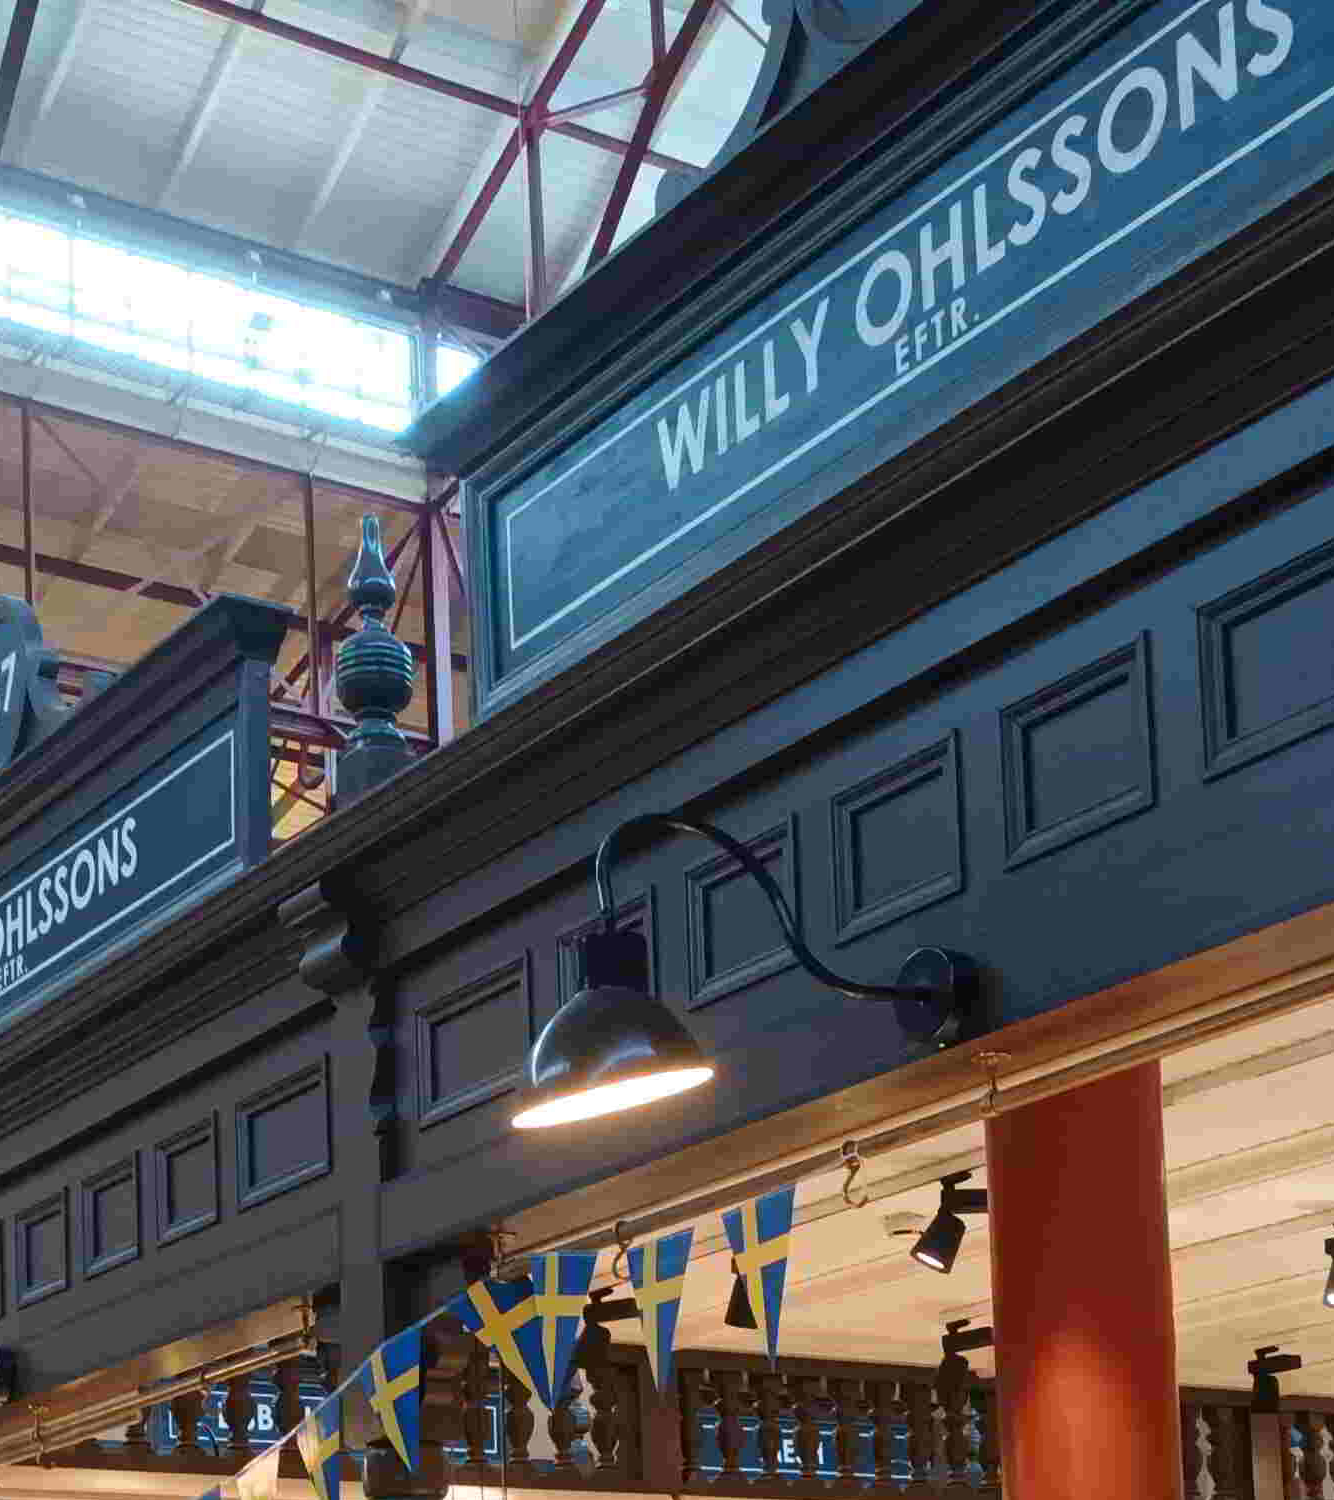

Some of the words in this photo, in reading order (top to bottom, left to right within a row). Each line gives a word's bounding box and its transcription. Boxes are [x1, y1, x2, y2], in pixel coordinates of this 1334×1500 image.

[657, 296, 829, 495] WILLY
[855, 0, 1294, 347] OHLSSONS
[895, 297, 980, 375] EFTR.
